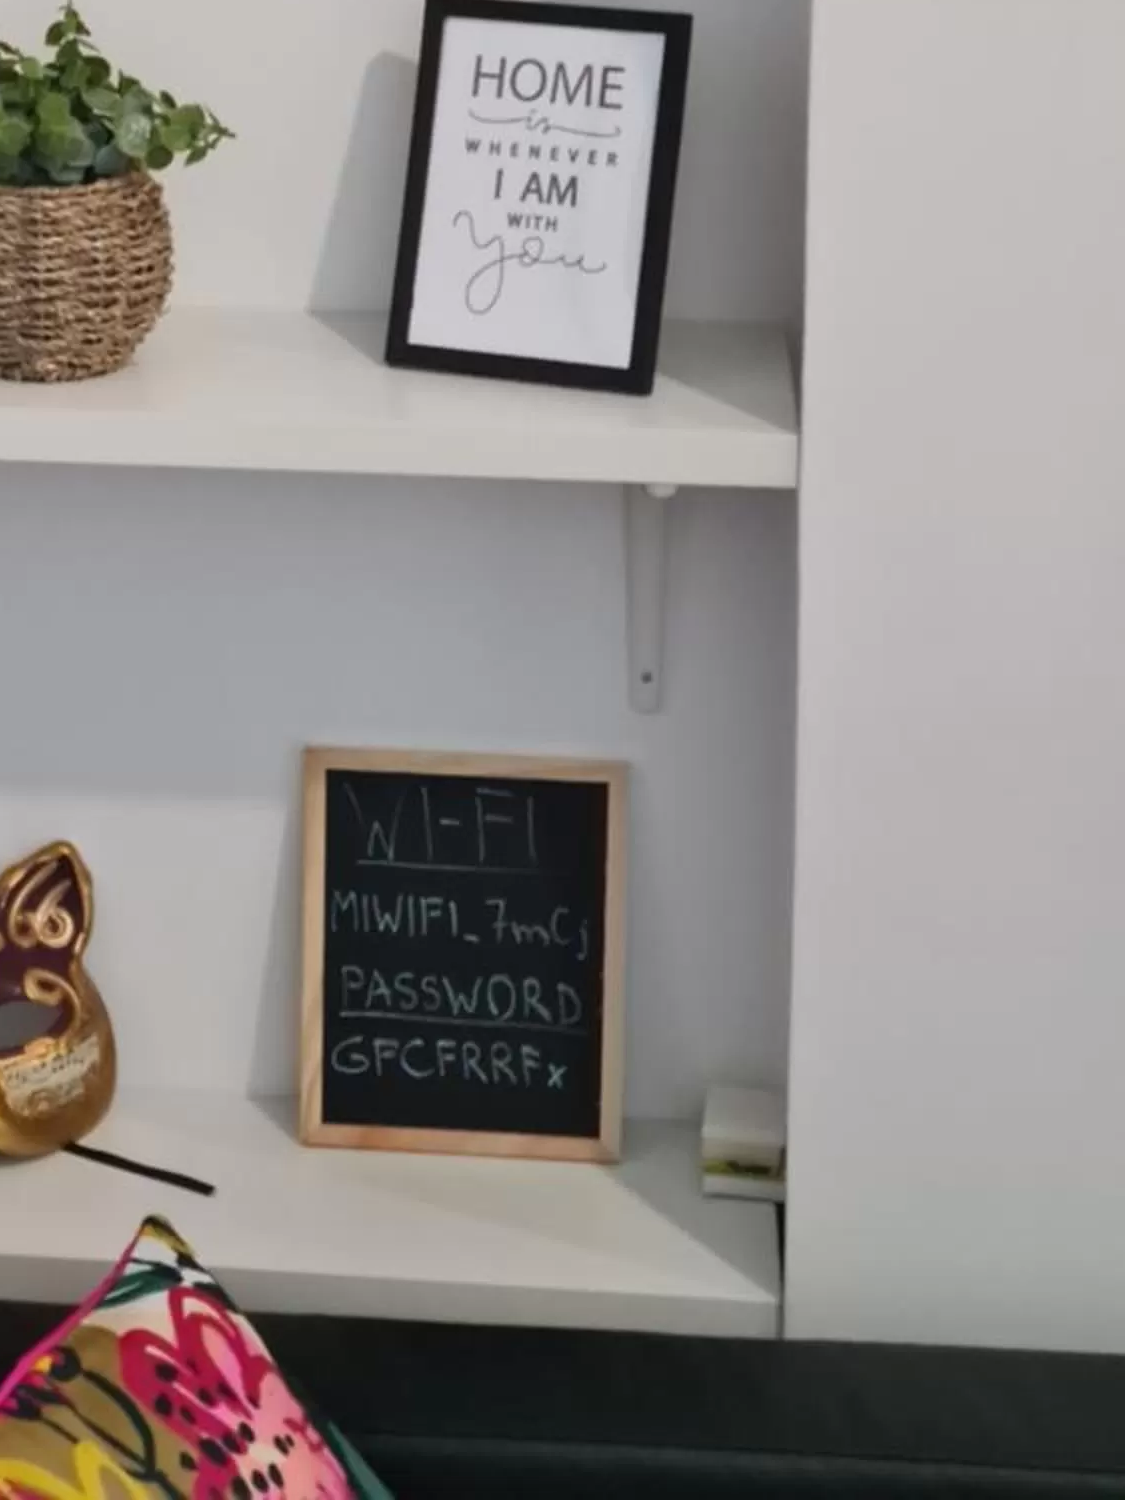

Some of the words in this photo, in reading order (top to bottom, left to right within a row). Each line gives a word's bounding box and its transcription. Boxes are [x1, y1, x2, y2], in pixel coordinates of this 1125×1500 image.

[471, 55, 626, 110] HOME
[464, 138, 619, 168] WHENEVER
[493, 168, 504, 199] I
[519, 172, 579, 207] AM
[506, 211, 559, 233] WITH
[340, 965, 583, 1026] PASSWORD
